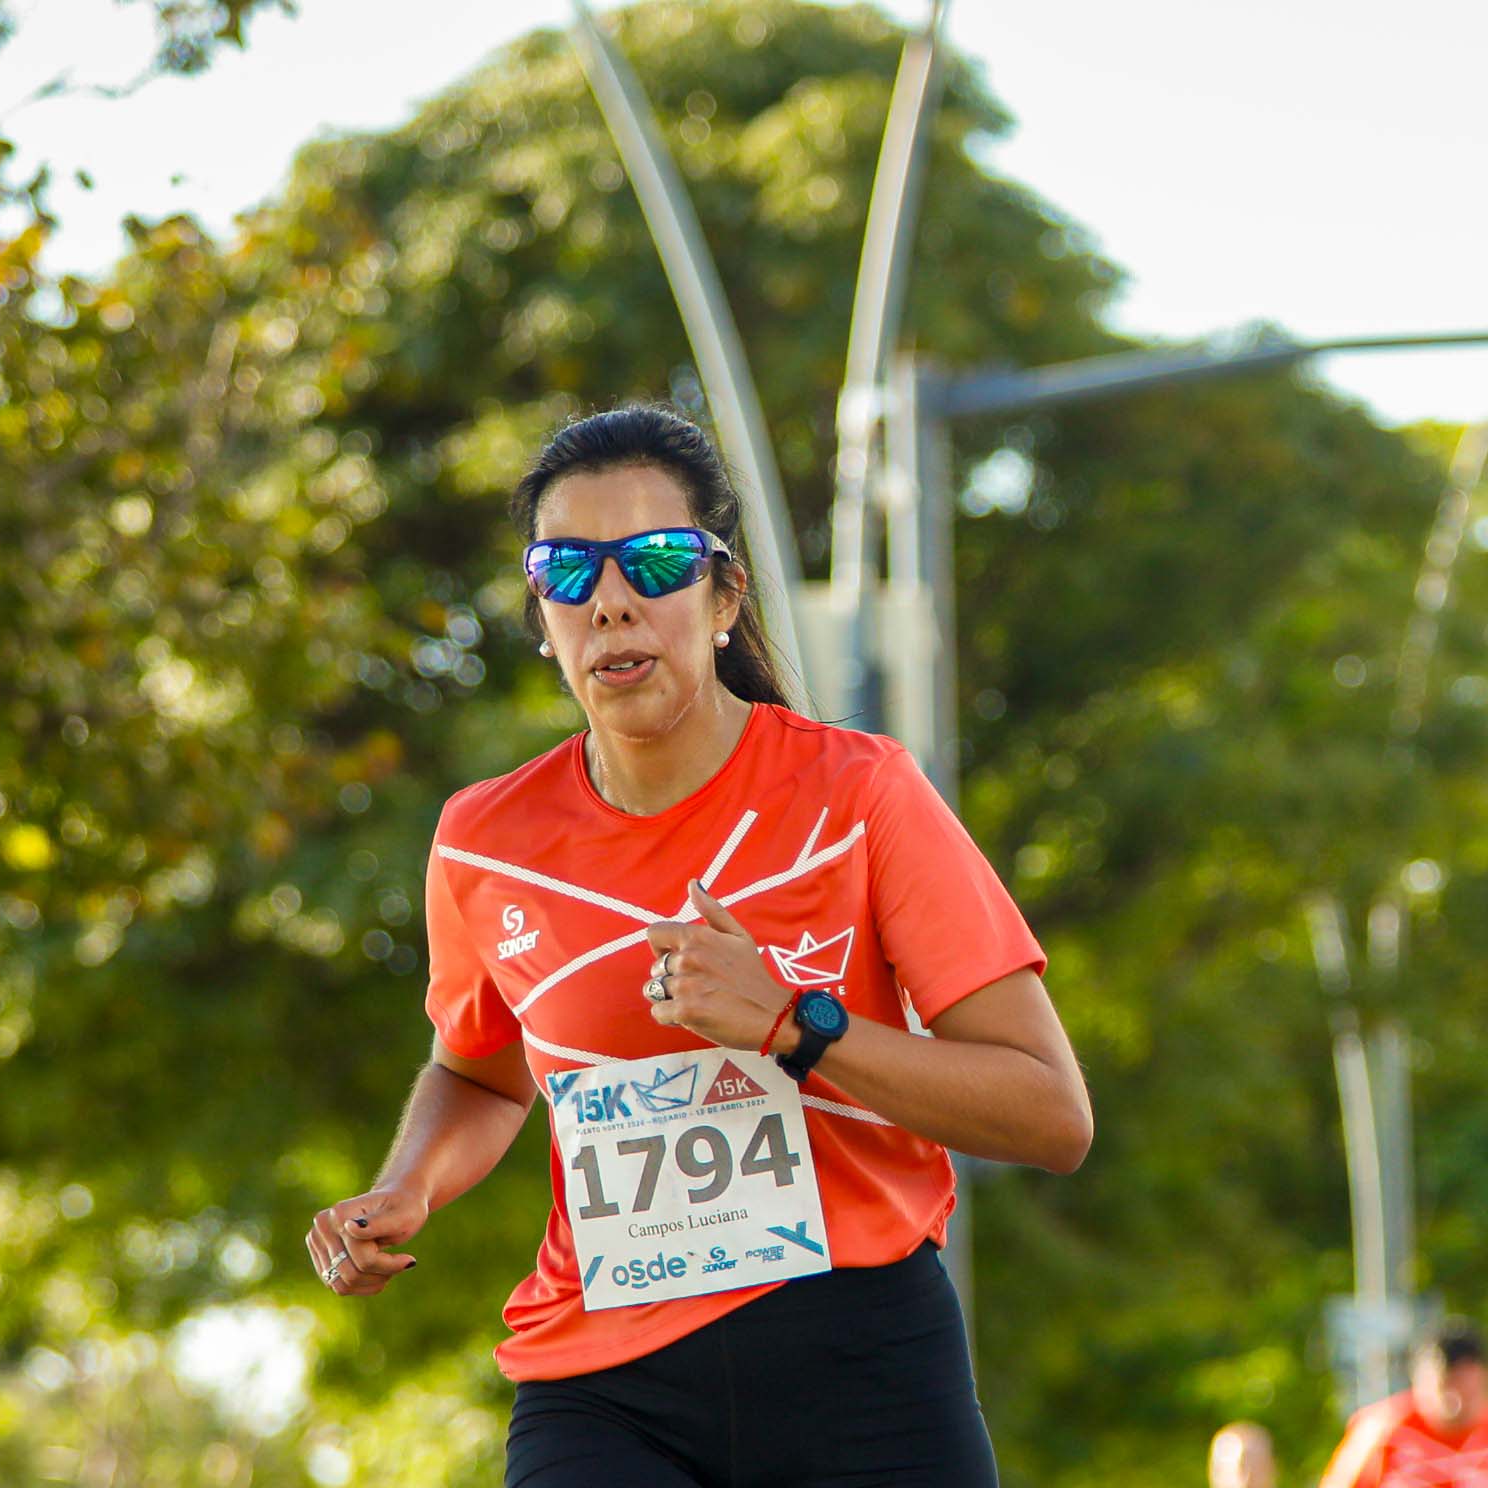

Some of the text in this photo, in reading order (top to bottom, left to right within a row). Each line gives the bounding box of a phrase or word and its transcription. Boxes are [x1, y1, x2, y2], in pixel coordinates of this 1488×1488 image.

[715, 1076, 752, 1097] 15K
[572, 1083, 632, 1124] 15K
[652, 1111, 687, 1124] ROSARIO
[707, 1106, 718, 1115] DE
[720, 1103, 744, 1113] ABRIL
[571, 1113, 801, 1219] 1794
[628, 1207, 749, 1239] Campos Luciana
[612, 1251, 687, 1286] osde
